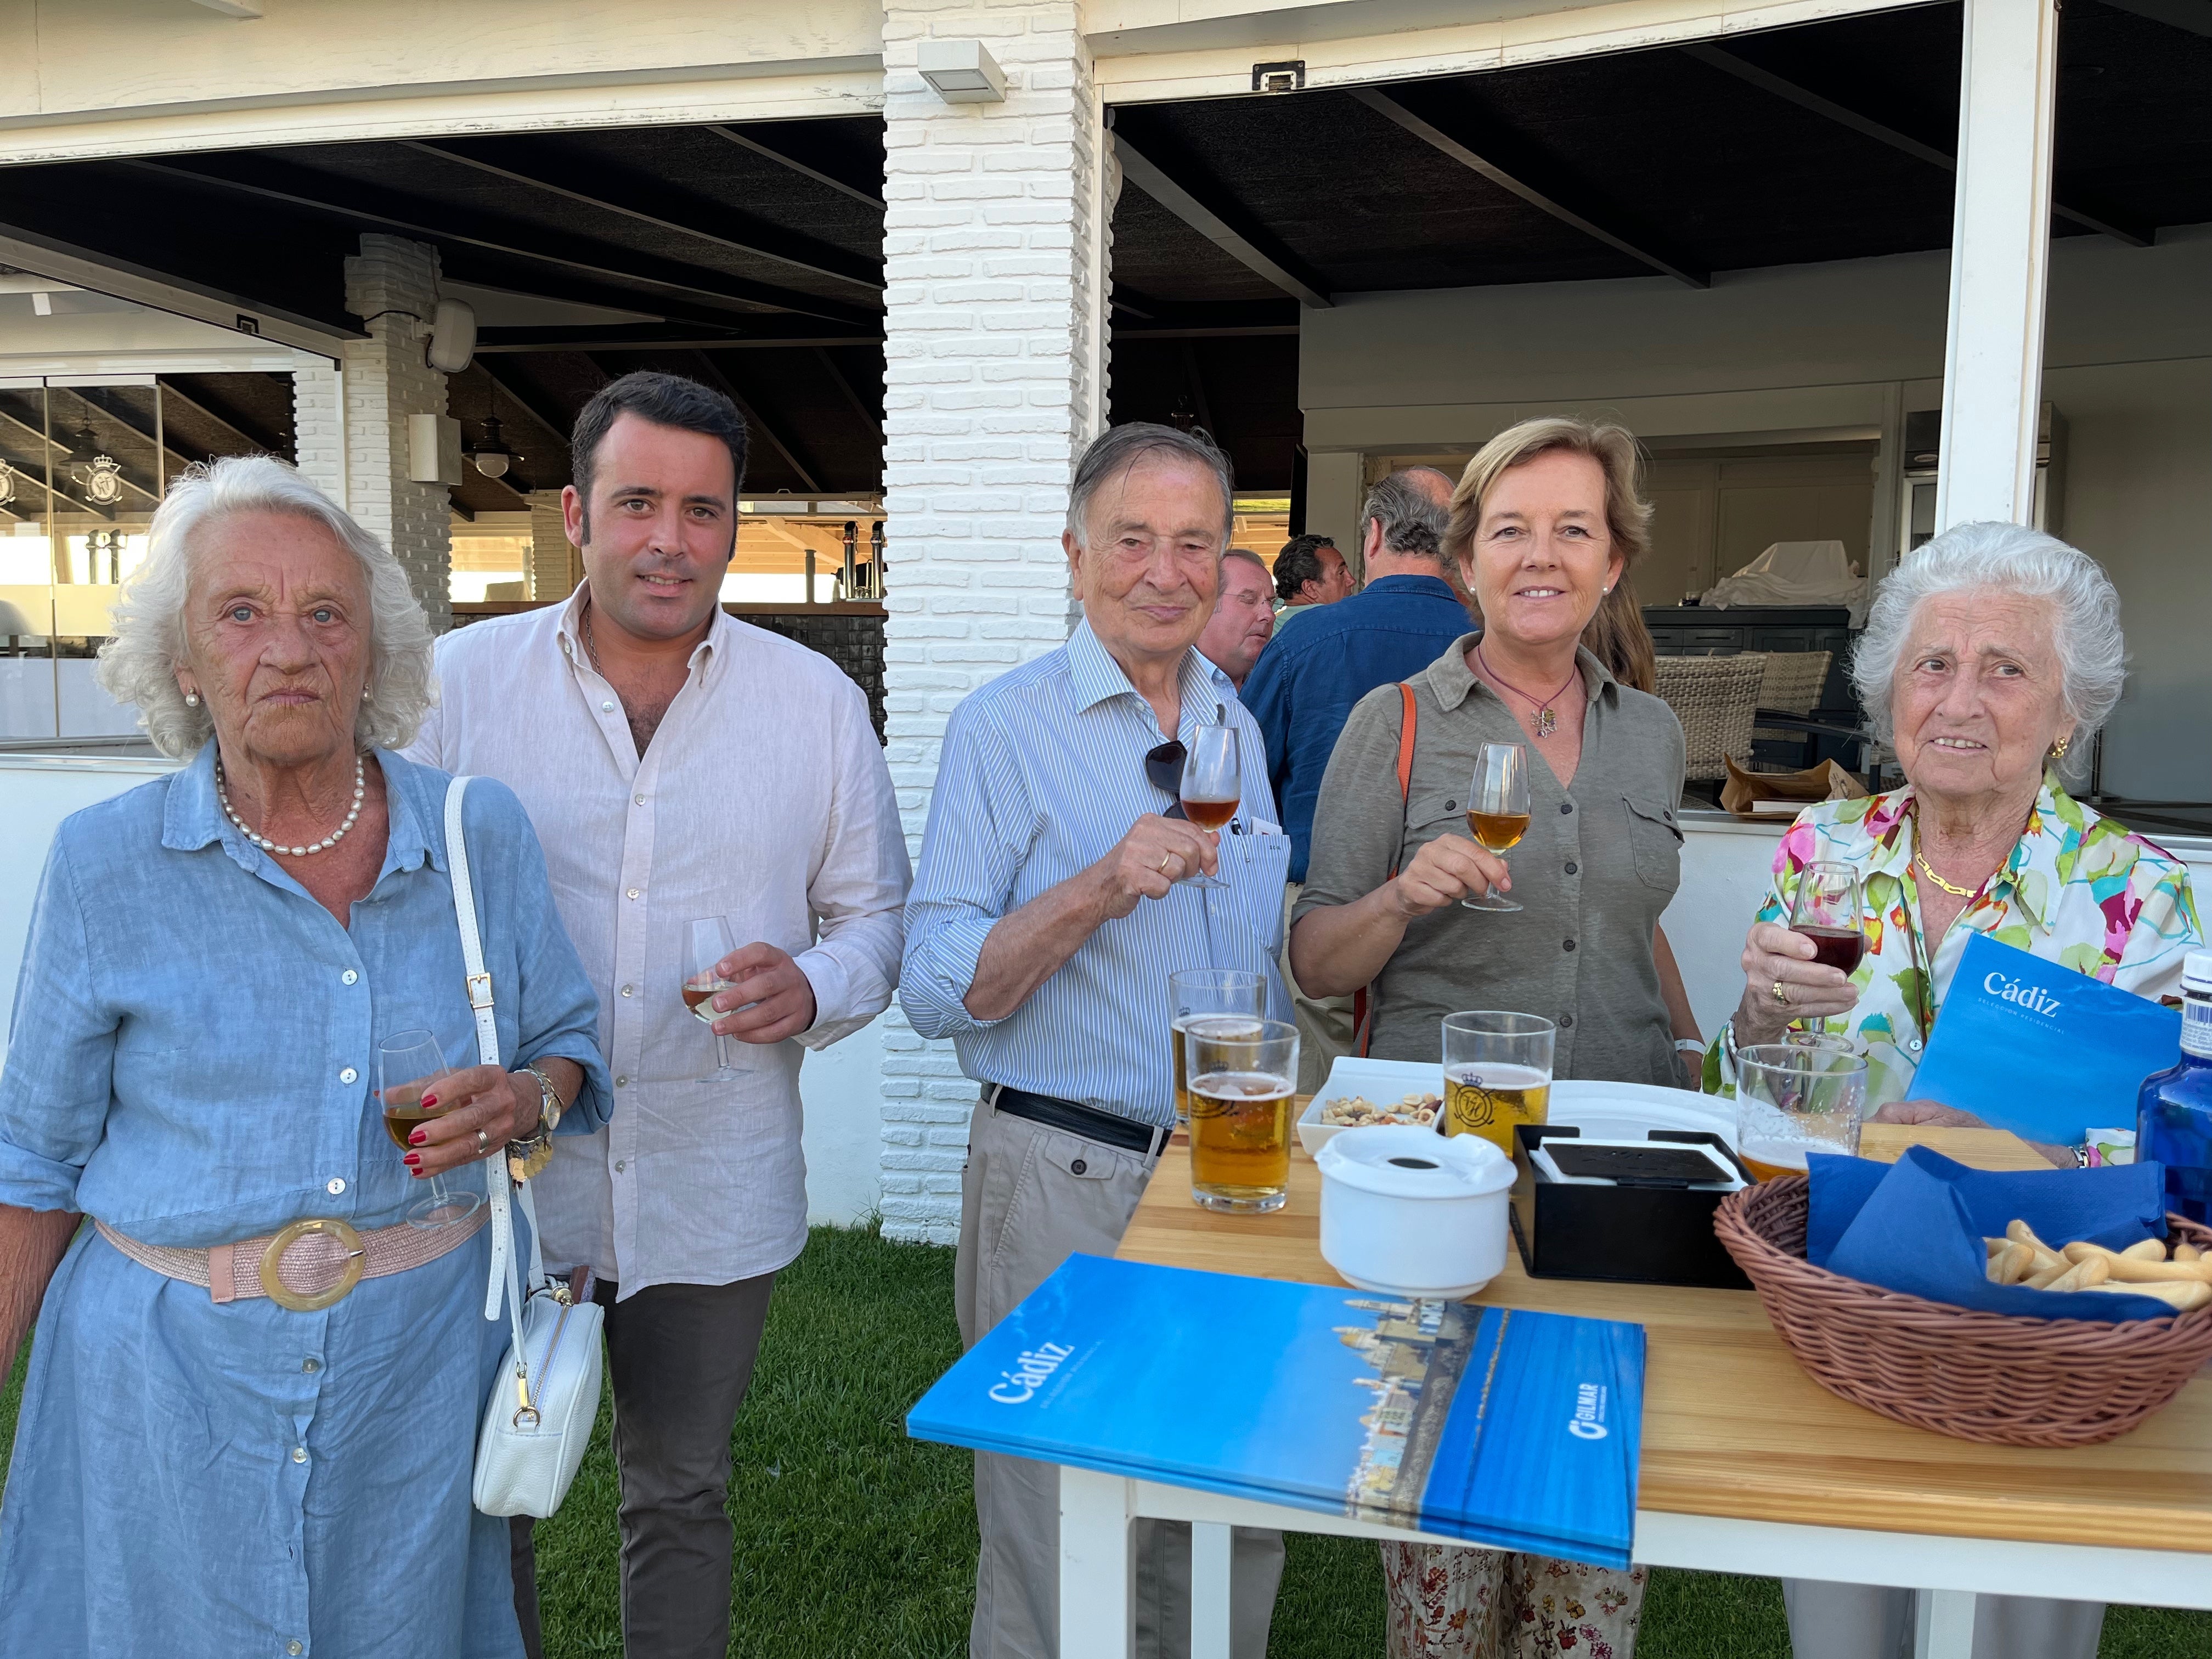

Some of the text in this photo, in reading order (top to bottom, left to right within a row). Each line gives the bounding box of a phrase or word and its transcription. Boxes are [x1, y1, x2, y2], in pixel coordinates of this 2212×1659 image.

[1984, 972, 2061, 1018] Cádiz
[2021, 1014, 2064, 1035] RESIDENCIAL
[989, 1342, 1075, 1404] Cádiz
[1576, 1384, 1599, 1421] GILMAR
